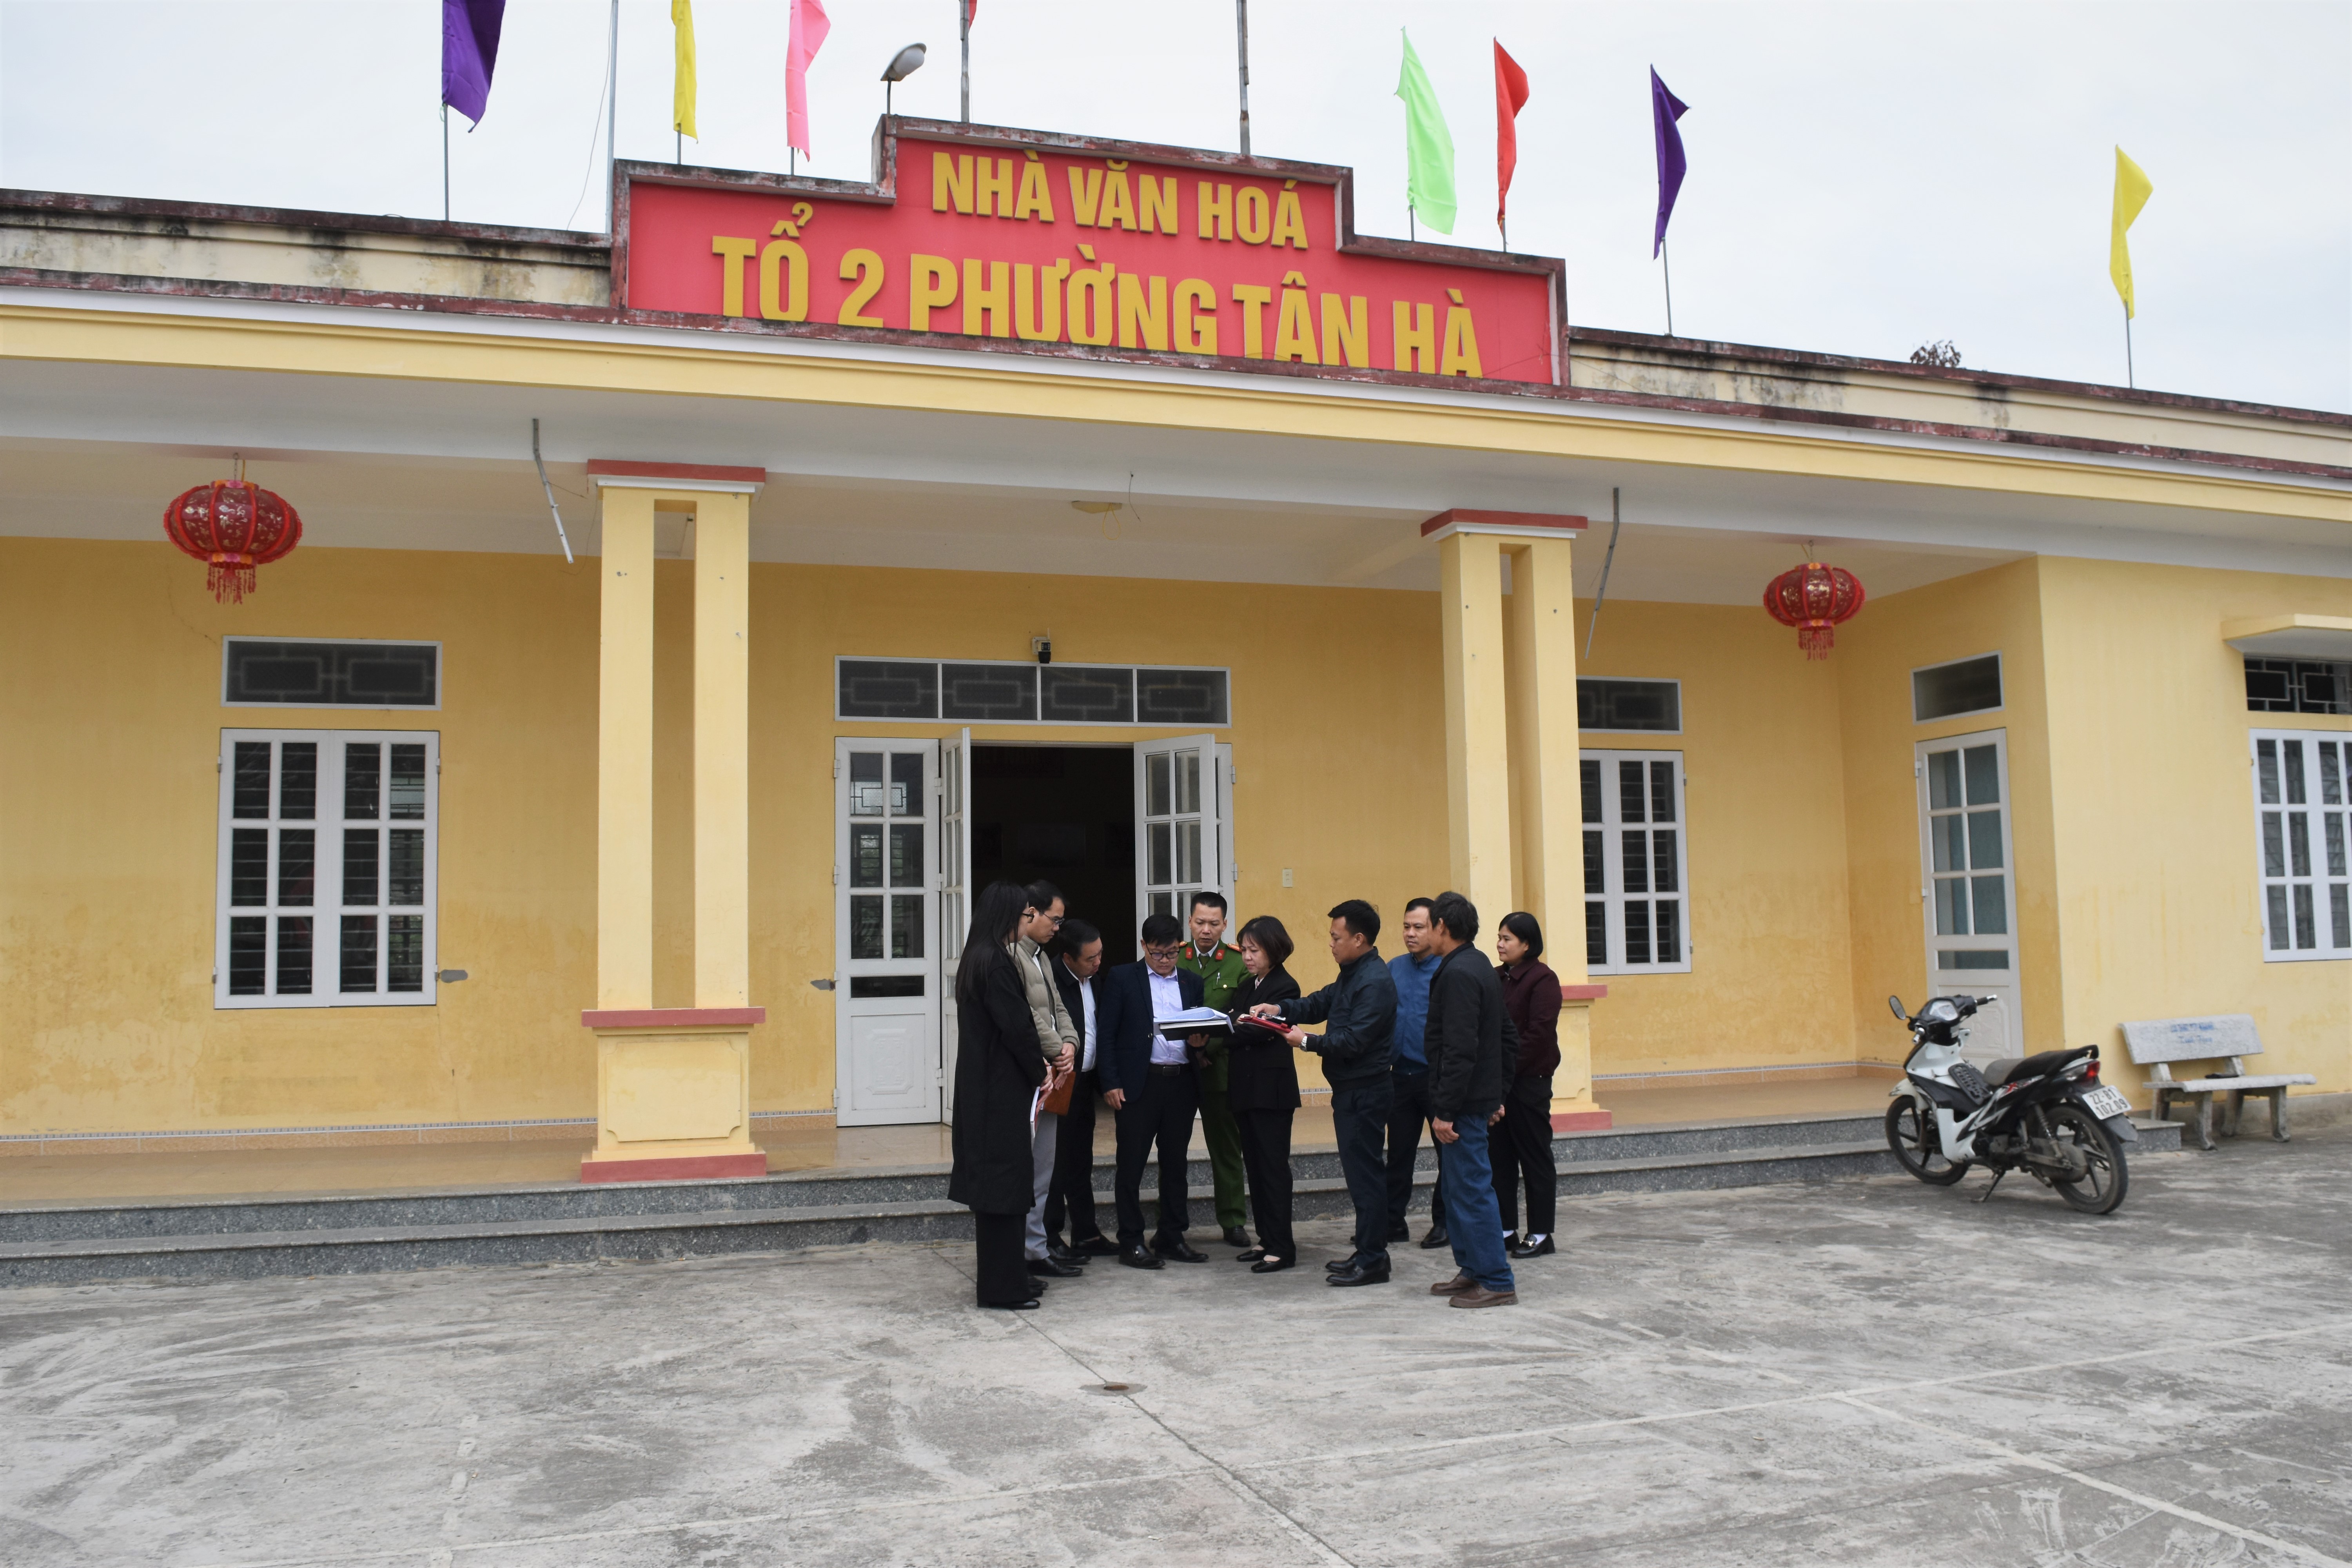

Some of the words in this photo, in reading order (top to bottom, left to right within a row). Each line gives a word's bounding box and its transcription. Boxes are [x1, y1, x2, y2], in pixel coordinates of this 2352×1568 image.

[933, 149, 1054, 223] NHÀ
[1068, 159, 1178, 235] VĂN
[1198, 179, 1308, 250] HOÁ
[712, 201, 813, 323] TỔ
[838, 248, 884, 328] 2
[910, 243, 1218, 357] PHƯỜNG
[1233, 270, 1369, 369] TÂN
[1394, 289, 1484, 379] HÀ
[2096, 1098, 2128, 1116] 102.09
